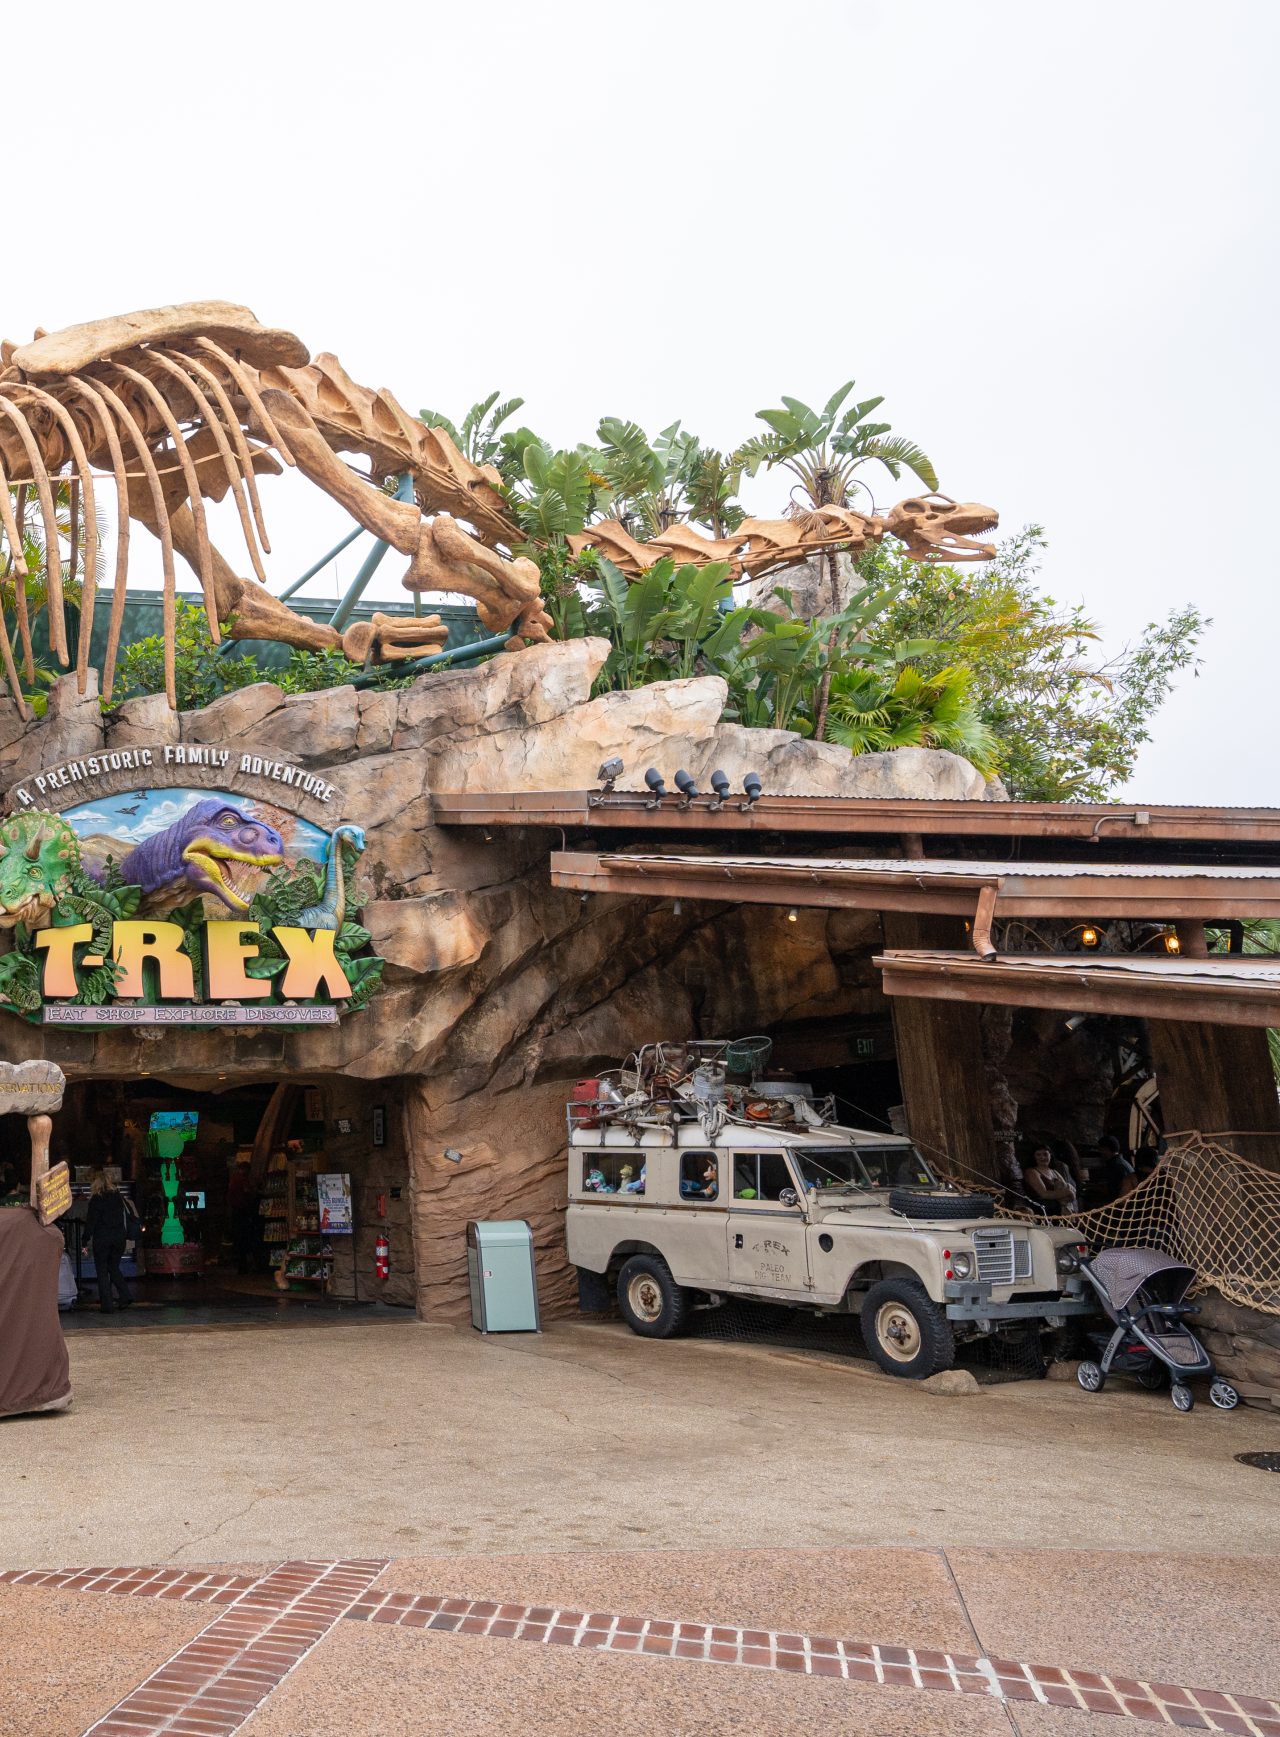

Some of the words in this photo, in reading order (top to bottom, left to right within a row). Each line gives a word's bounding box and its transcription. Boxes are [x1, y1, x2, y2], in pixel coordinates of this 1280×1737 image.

[16, 788, 35, 806] A
[34, 749, 153, 795] PREHISTORIC
[163, 745, 230, 767] FAMILY
[239, 754, 336, 803] ADVENTURE
[35, 920, 353, 999] T-REX
[48, 1007, 87, 1021] EAT
[95, 1008, 146, 1021] SHOP
[153, 1007, 237, 1021] EXPLORE
[245, 1007, 333, 1021] DISCOVER
[857, 1039, 874, 1055] EXIT
[760, 1262, 785, 1273] PALEO
[754, 1270, 767, 1280] DIG
[771, 1272, 792, 1282] TEAM
